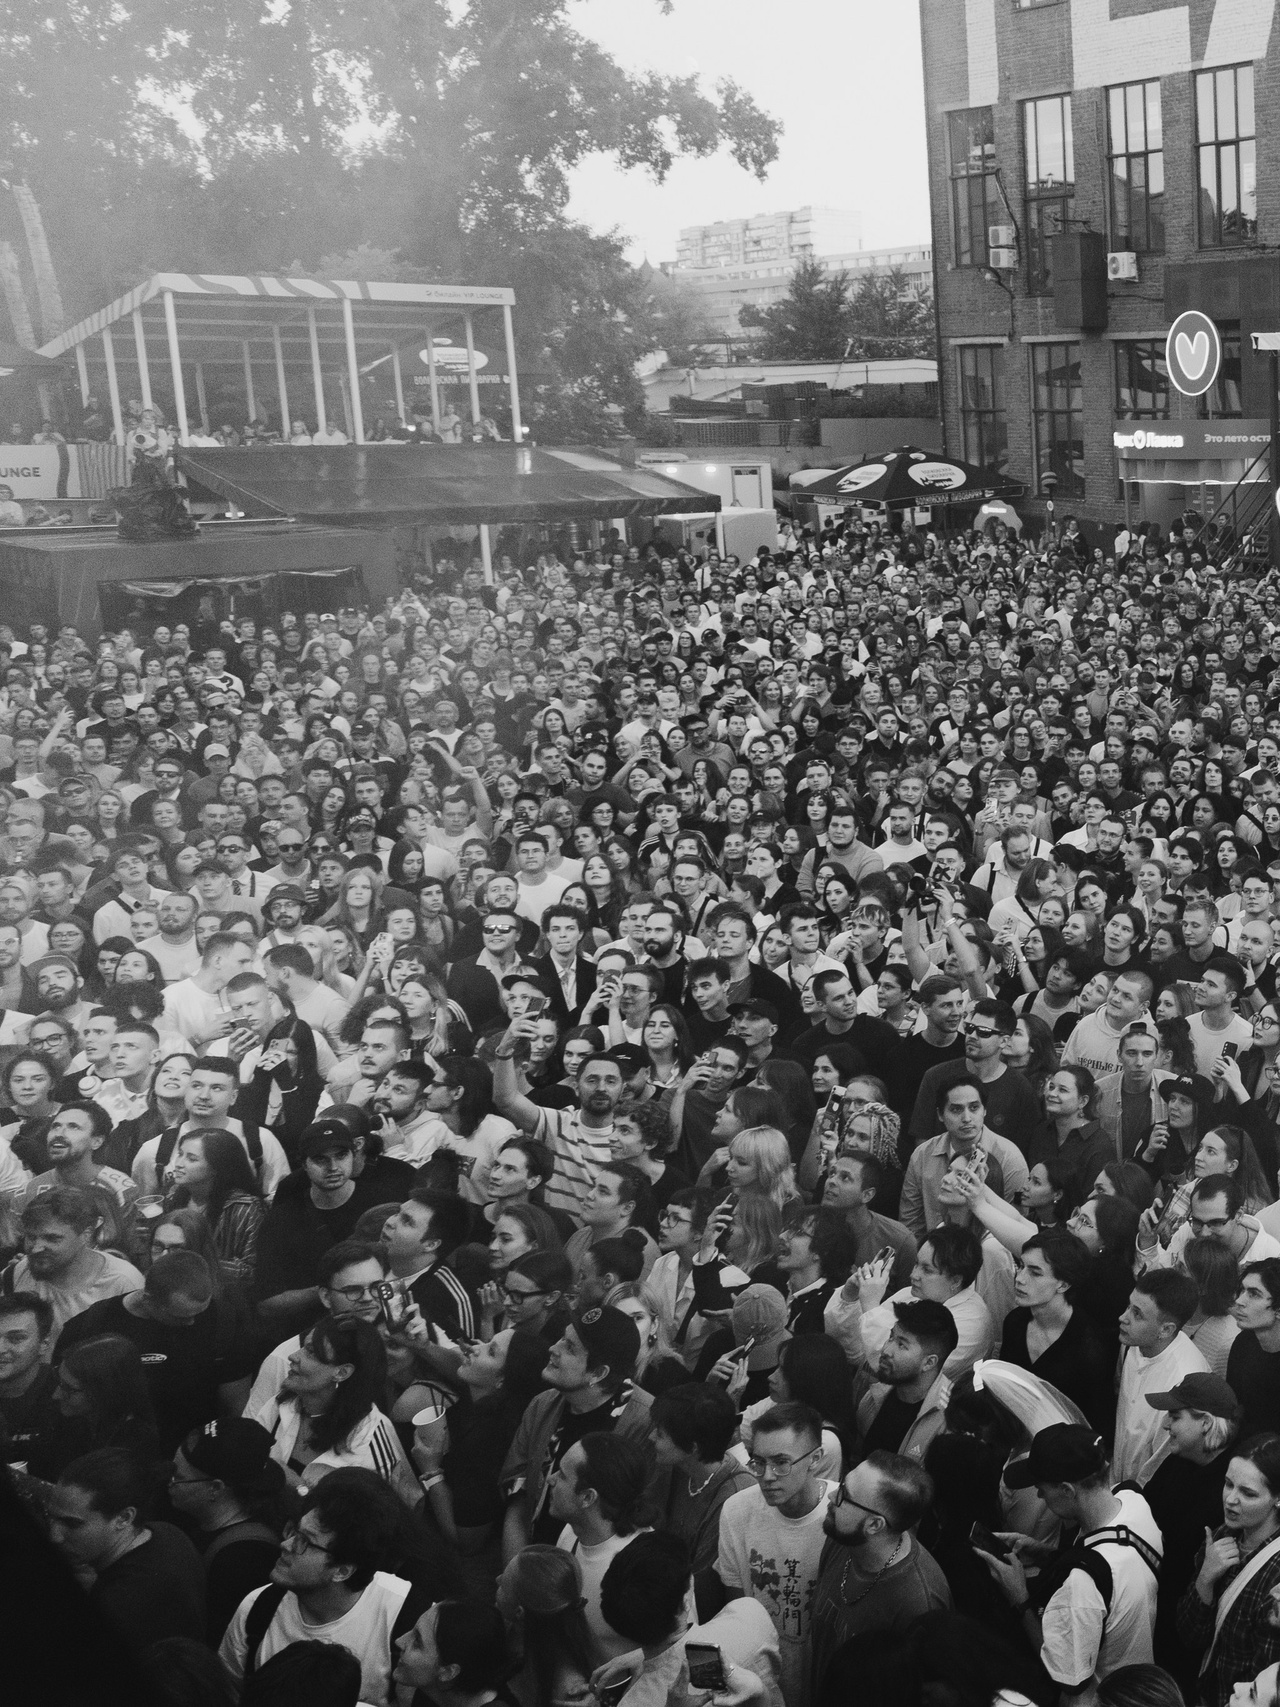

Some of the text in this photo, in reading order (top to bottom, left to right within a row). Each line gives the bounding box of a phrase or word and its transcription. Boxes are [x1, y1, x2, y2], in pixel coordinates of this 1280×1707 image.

[1145, 431, 1184, 448] Лавка
[1204, 434, 1224, 443] Это
[1224, 435, 1249, 443] лето
